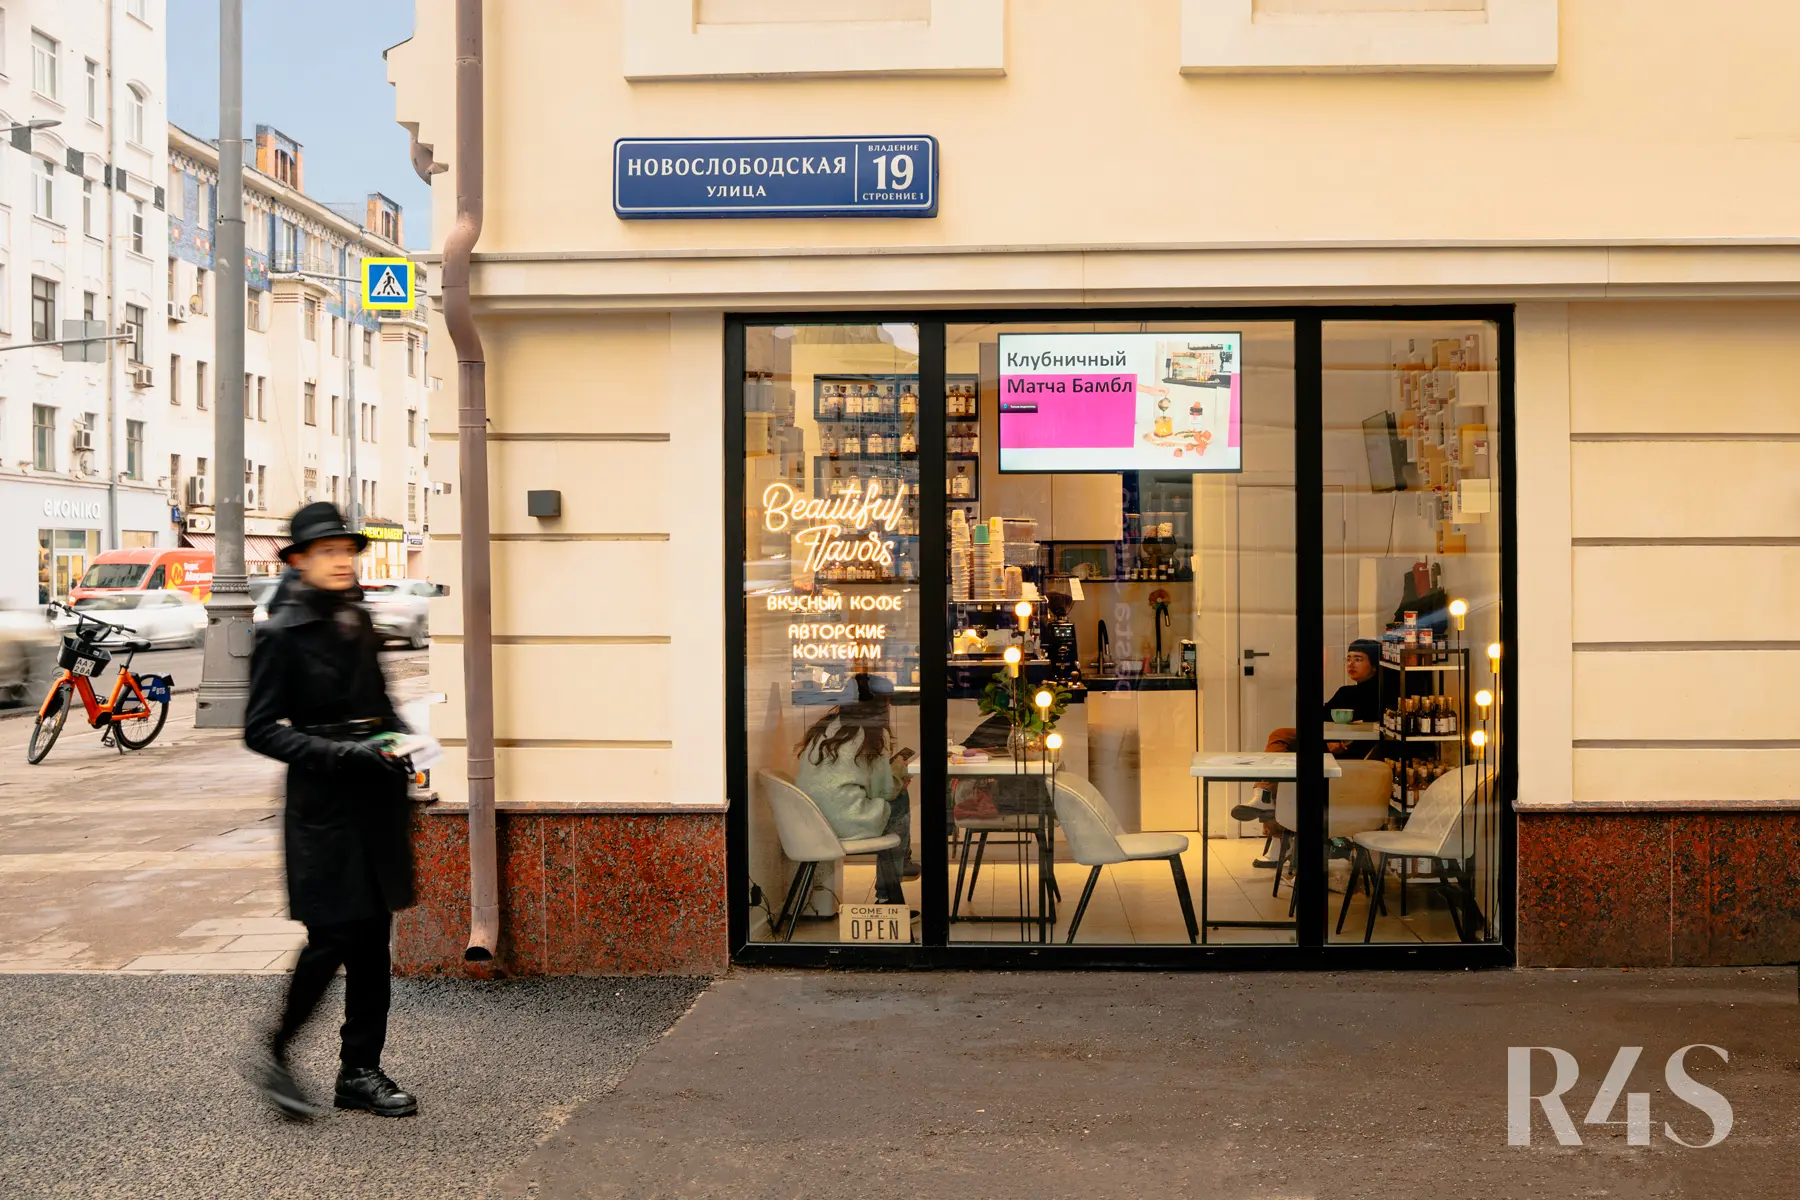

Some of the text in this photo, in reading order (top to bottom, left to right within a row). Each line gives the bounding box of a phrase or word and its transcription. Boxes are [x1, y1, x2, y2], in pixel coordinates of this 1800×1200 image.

[868, 144, 920, 152] ВЛАДЕНИЕ
[627, 156, 847, 178] НОВОСЛОБОДСКАЯ
[872, 154, 914, 190] 19
[706, 185, 767, 198] УЛИЦА
[862, 192, 924, 201] СТРОЕНИЕ 1
[1006, 351, 1127, 371] Клубничный
[1007, 377, 1132, 393] Матча Бамбл
[763, 482, 905, 532] Beautiful
[795, 524, 894, 573] Flavors
[767, 592, 902, 612] ВКУСНЫЙ КОФЕ
[788, 622, 886, 640] АВТОРСКИЕ
[793, 641, 882, 660] КОКТЕЙЛИ
[851, 907, 899, 915] COME IN
[851, 919, 899, 940] OPEN
